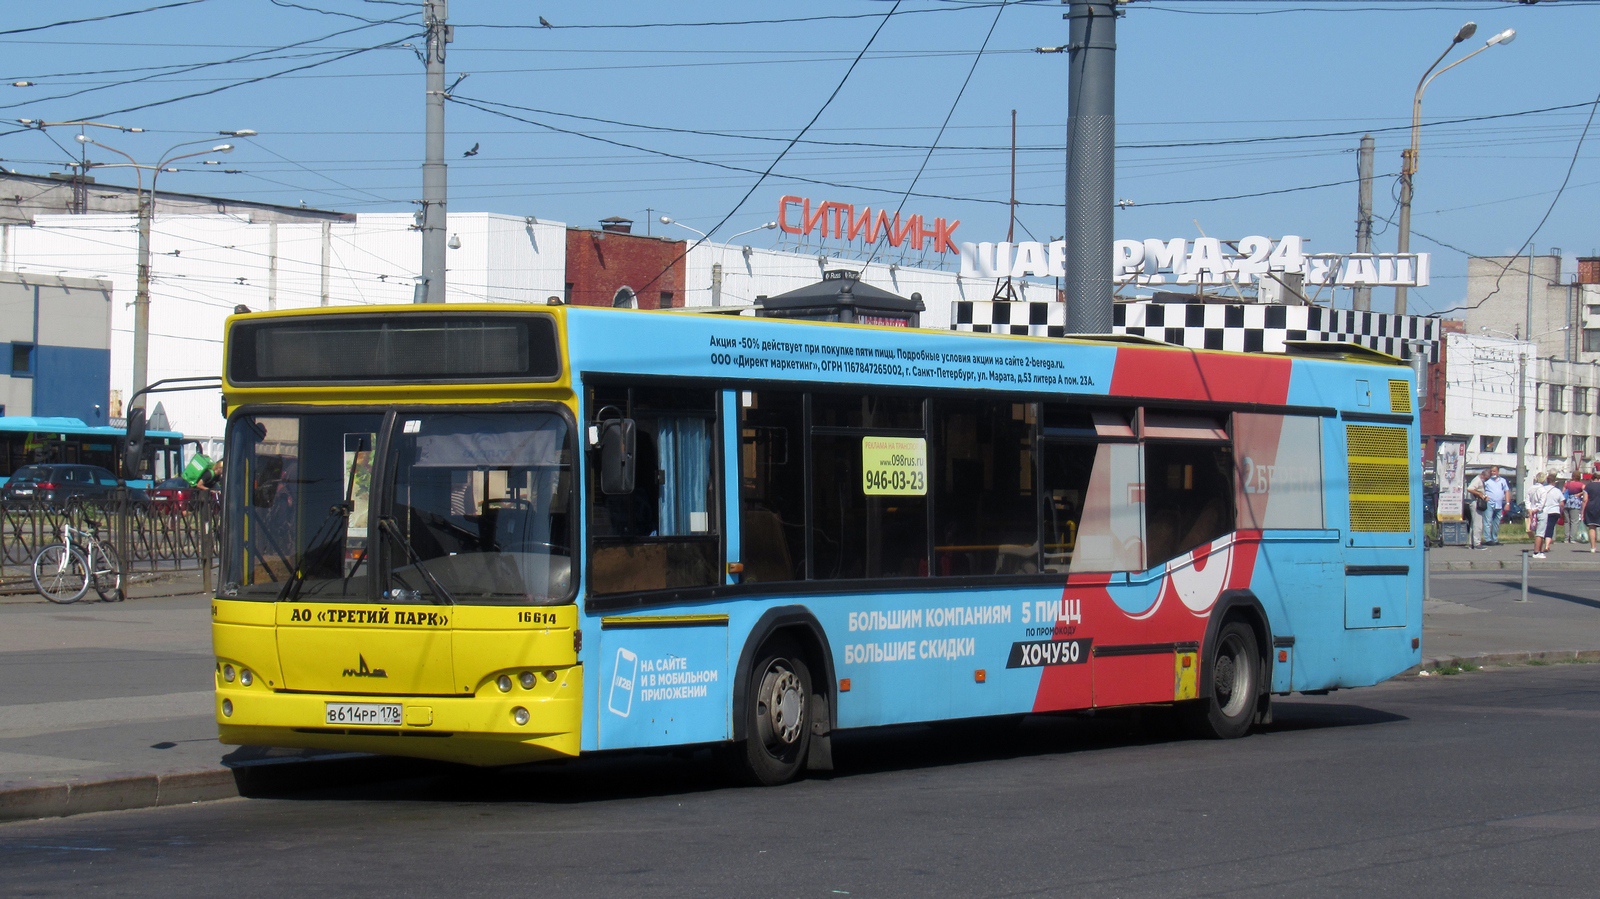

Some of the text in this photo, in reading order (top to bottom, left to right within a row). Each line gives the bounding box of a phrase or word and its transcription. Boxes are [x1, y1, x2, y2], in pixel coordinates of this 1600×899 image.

[779, 195, 961, 255] СИТИЛИНК
[960, 235, 1305, 278] ШАРМА 24
[710, 335, 737, 349] Акция
[738, 337, 760, 349] -50%
[761, 342, 802, 353] действует
[804, 344, 820, 355] при
[821, 345, 854, 357] покупке
[855, 348, 873, 357] пяти
[874, 349, 896, 360] пицц.
[897, 349, 940, 363] Подробные
[942, 354, 971, 363] условия
[972, 356, 994, 365] акции
[1004, 357, 1024, 366] сайте
[710, 353, 731, 365] ООО
[733, 355, 769, 368] «Директ
[821, 361, 843, 372] ОГРН
[912, 368, 976, 382] Санкт-Петербург,
[977, 373, 988, 381] ул.
[989, 372, 1017, 384] Марата,
[1017, 373, 1032, 383] д.53
[1033, 376, 1057, 385] литера
[1057, 375, 1063, 384] А
[1080, 376, 1095, 386] 23А.
[866, 470, 924, 490] 946-03-23
[291, 607, 449, 626] АО «ТРЕТИЙ ПАРК»
[517, 611, 557, 625] 16614
[848, 604, 1012, 632] БОЛЬШИМ КОМПАНИЯМ
[1021, 599, 1081, 624] 5 ПИЦЦ
[1025, 625, 1077, 637] ПО ПРОМОКОДУ
[844, 637, 976, 665] БОЛЬШИЕ СКИДКИ
[1020, 640, 1080, 666] ХОЧУ50
[641, 655, 687, 672] НА САЙТЕ
[641, 669, 718, 687] И В МОБИЛЬНОМ
[641, 685, 707, 702] ПРИЛОЖЕНИИ
[380, 706, 398, 718] 178
